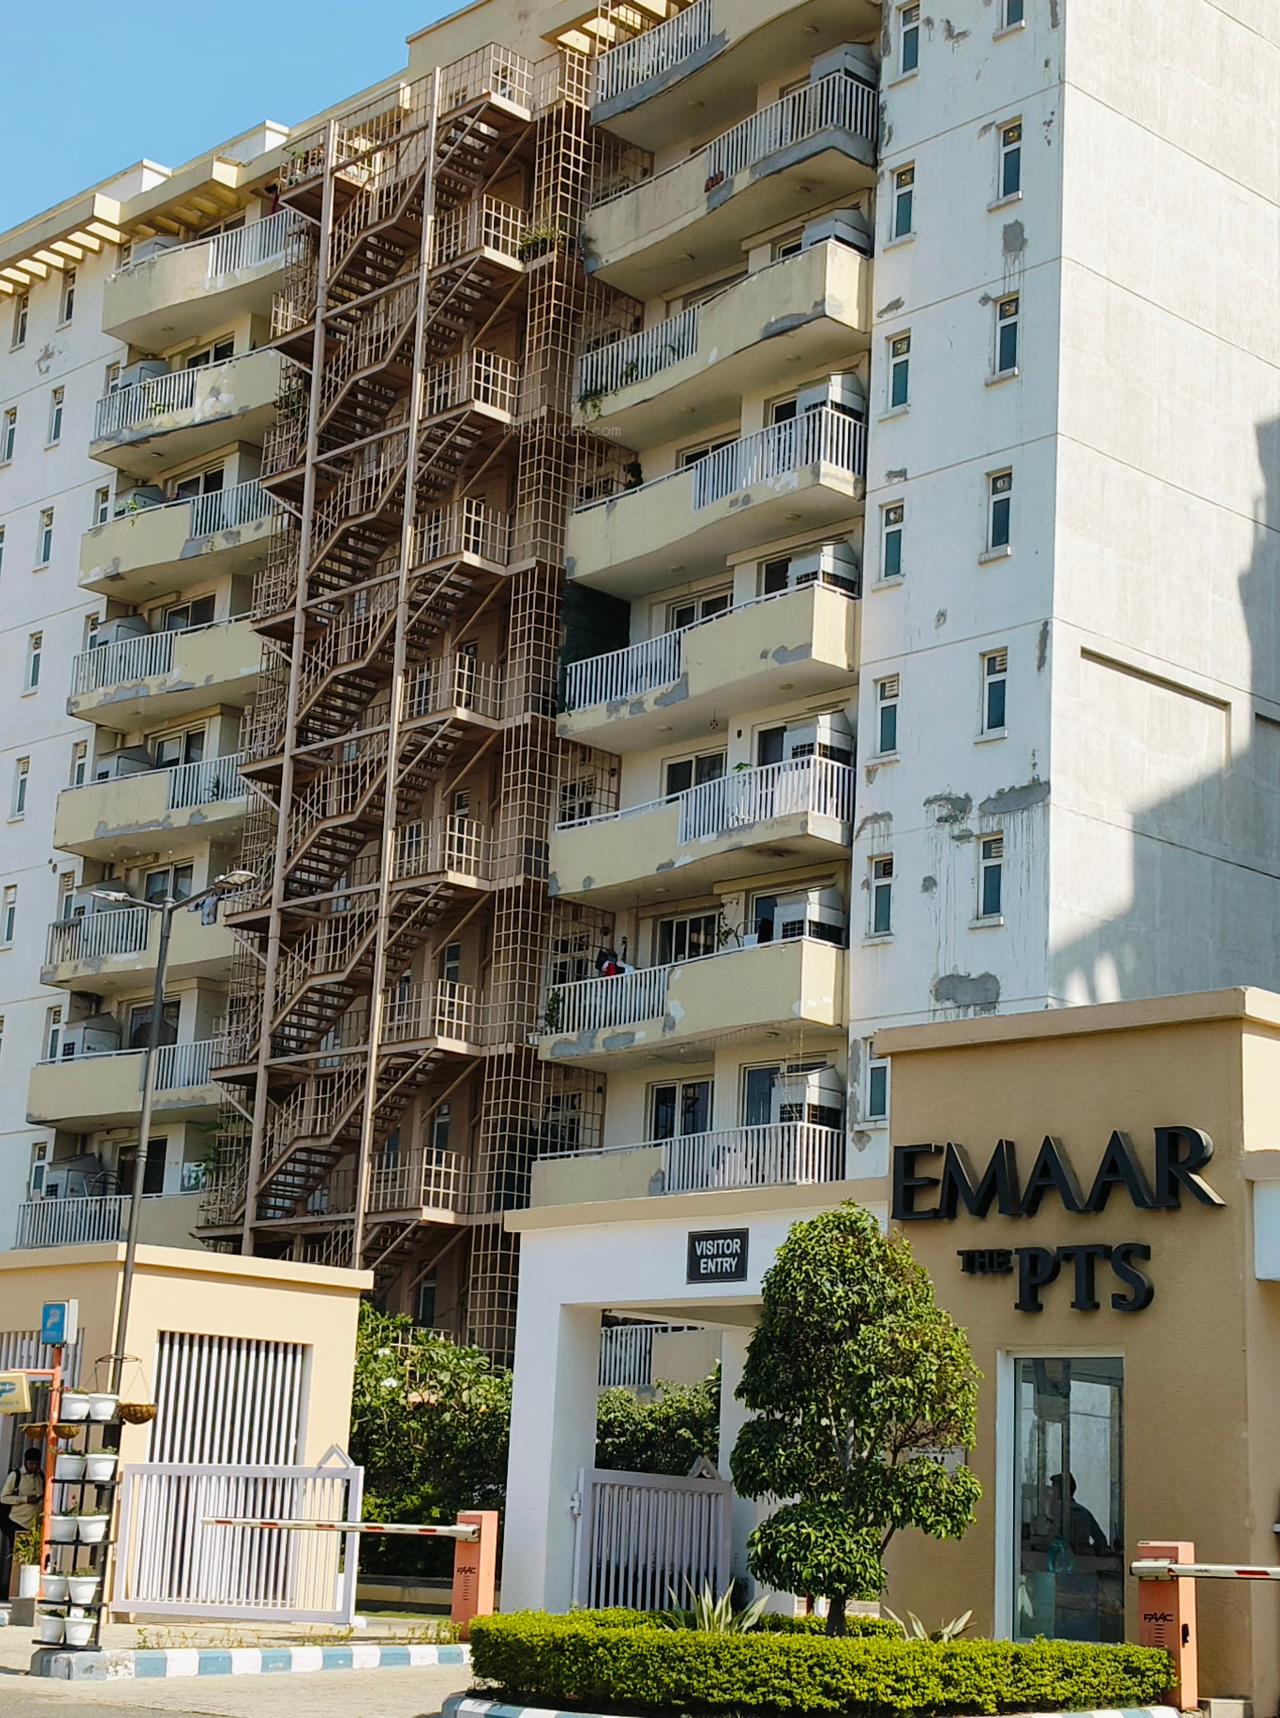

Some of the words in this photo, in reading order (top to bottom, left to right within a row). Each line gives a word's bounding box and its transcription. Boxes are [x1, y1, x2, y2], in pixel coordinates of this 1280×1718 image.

[892, 1126, 1226, 1220] EMAAR
[695, 1238, 741, 1256] VISITOR
[700, 1256, 738, 1274] ENTRY
[957, 1249, 1013, 1274] THE
[1014, 1243, 1155, 1312] PTS
[457, 1566, 476, 1575] FAAC
[1143, 1612, 1174, 1623] FAAC
